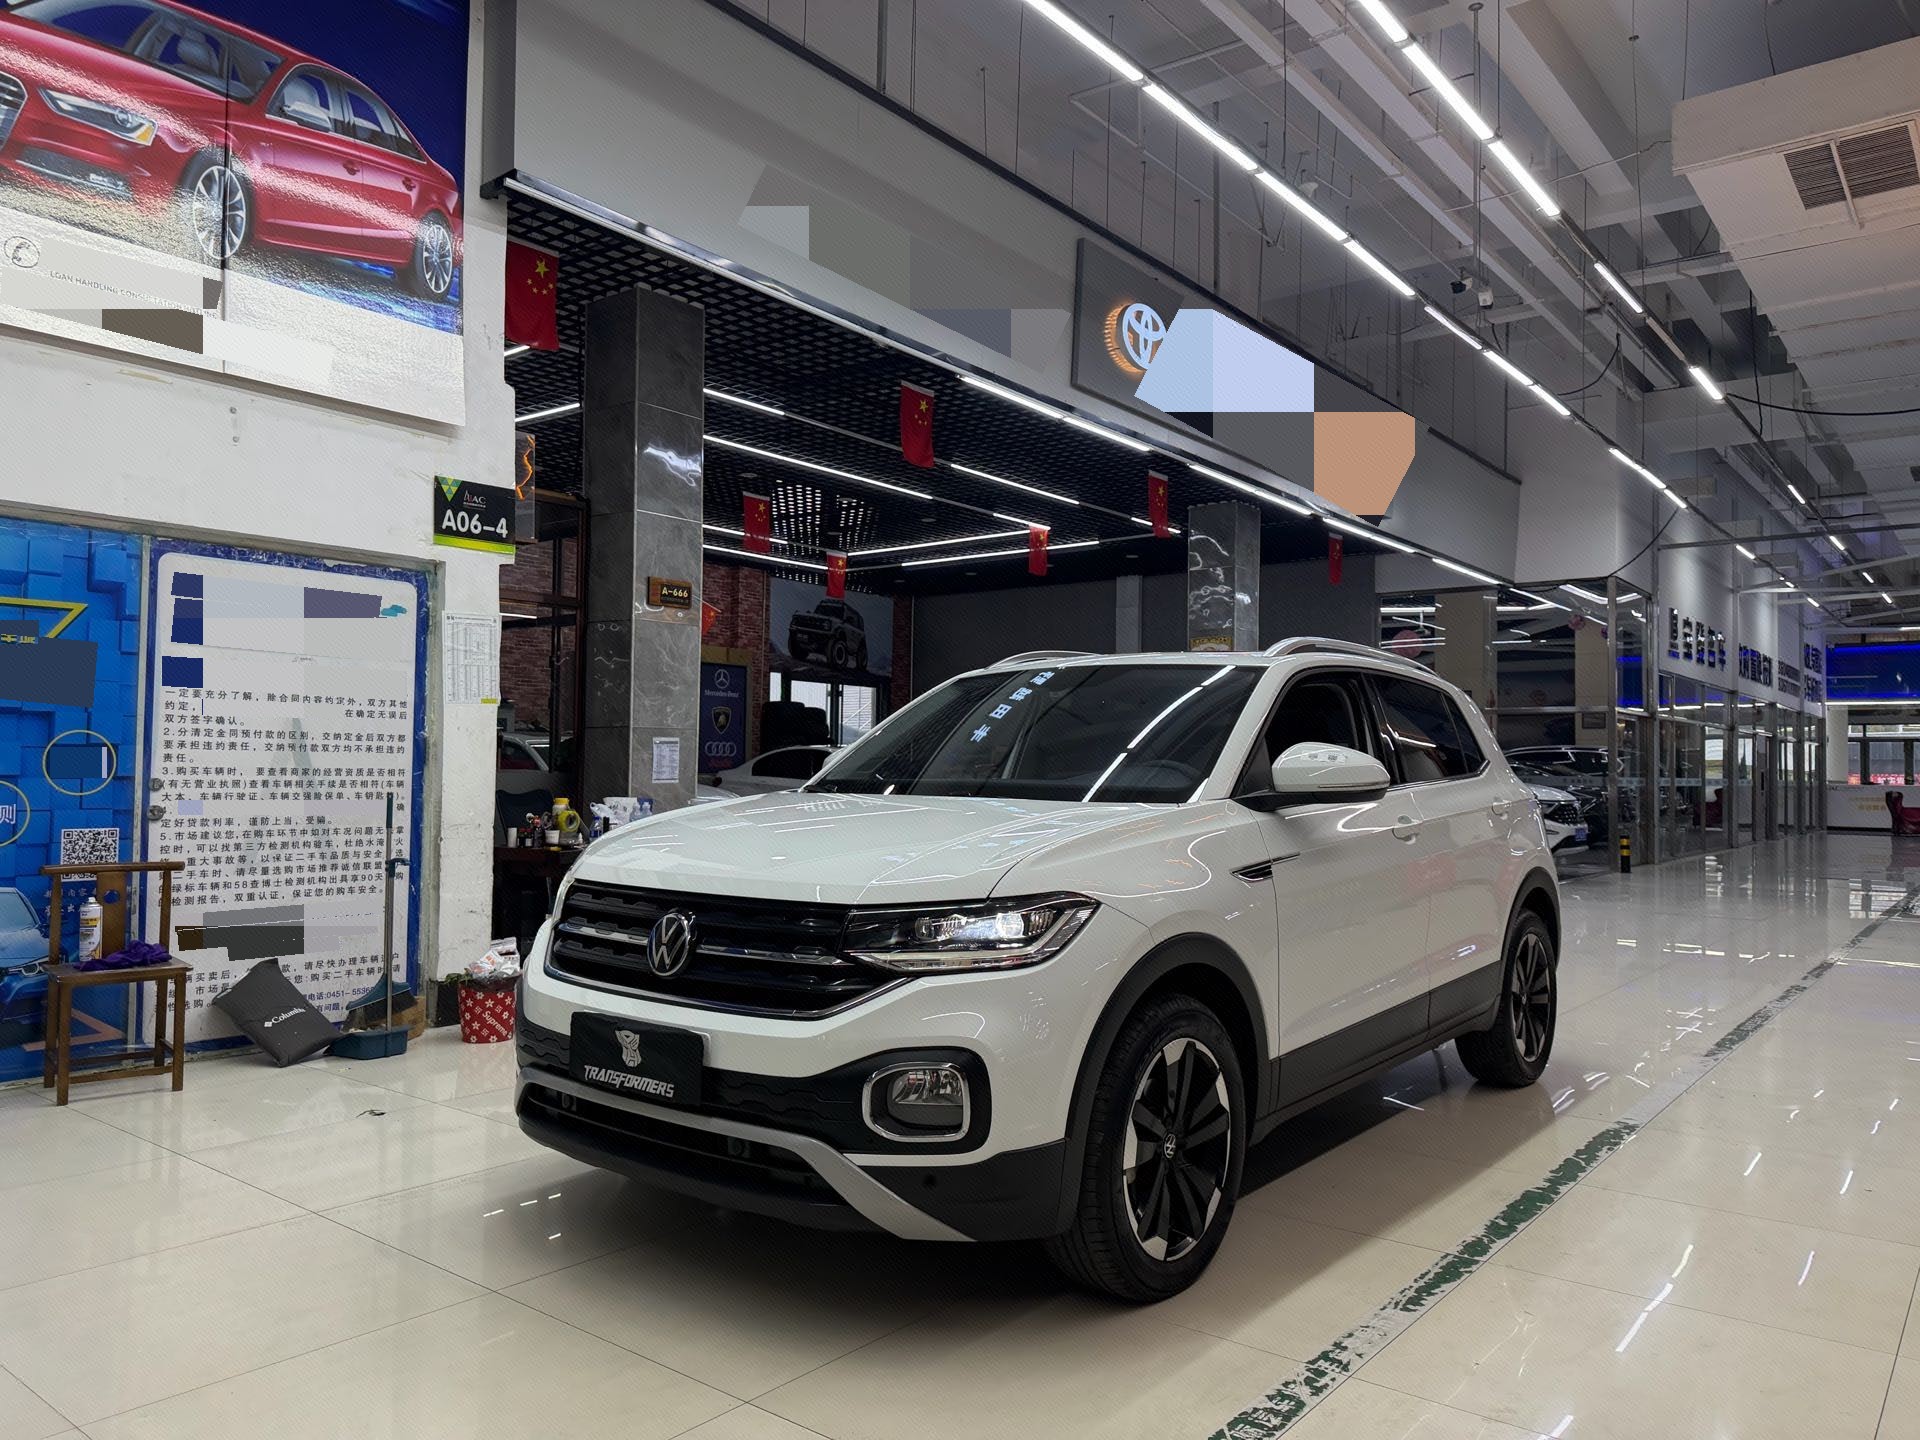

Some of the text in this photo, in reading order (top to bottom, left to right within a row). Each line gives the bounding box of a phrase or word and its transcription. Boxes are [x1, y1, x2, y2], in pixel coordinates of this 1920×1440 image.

[75, 277, 119, 294] HANDLING
[441, 508, 509, 539] A06-4
[661, 586, 689, 598] A-666
[344, 708, 408, 720] 在确定无误后
[162, 752, 194, 764] 责任。
[159, 825, 405, 842] 5.市场建议您，在购车环节中如对车况问题无掌
[482, 1010, 509, 1037] Supreme
[584, 1064, 675, 1098] TRANSFORMERS
